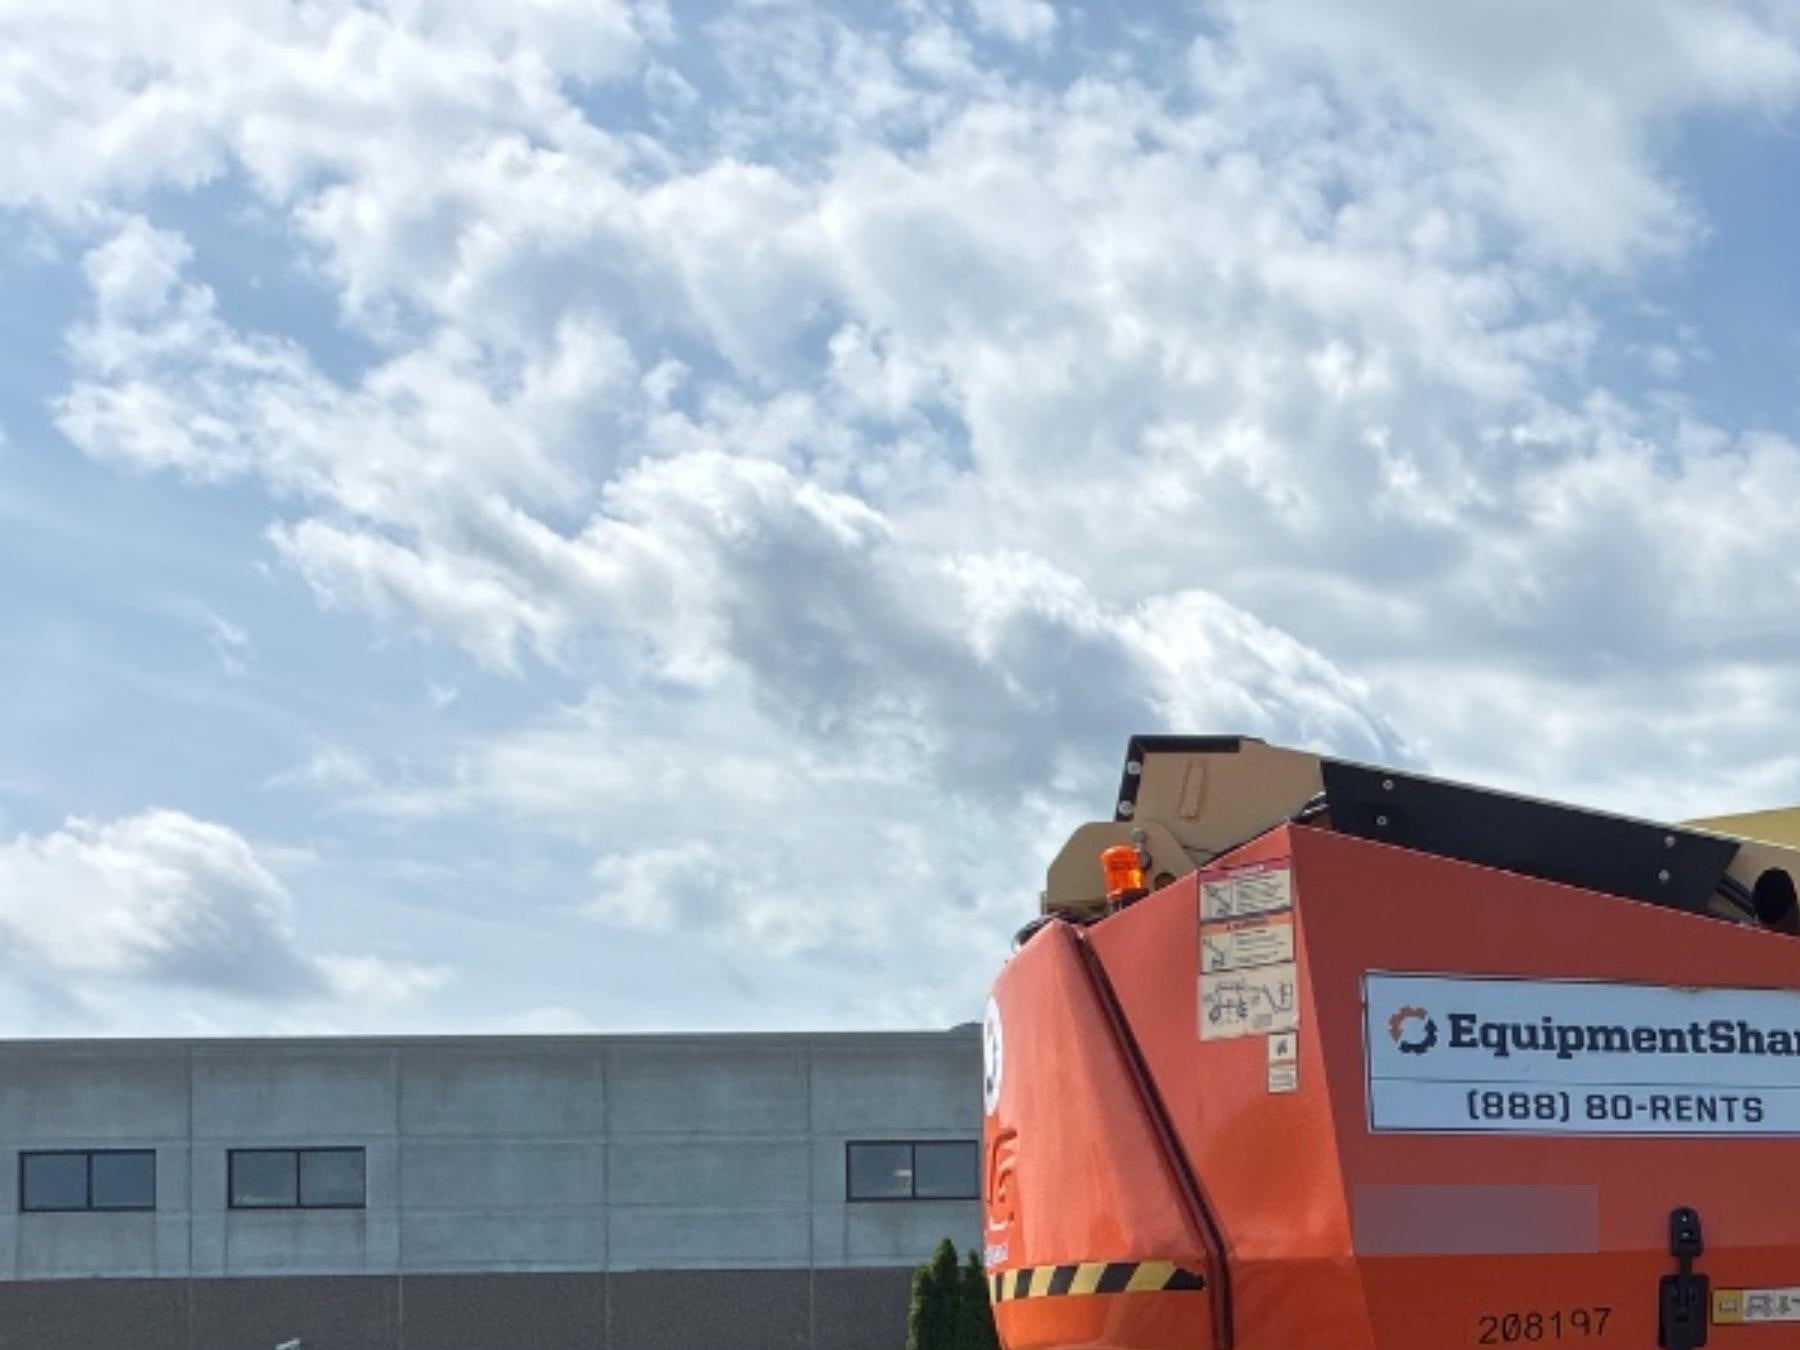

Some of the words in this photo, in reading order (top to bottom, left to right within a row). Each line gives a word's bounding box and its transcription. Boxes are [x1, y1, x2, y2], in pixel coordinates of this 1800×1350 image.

[1467, 1089, 1570, 1122] (888)
[1585, 1093, 1764, 1124] 80-RENTS
[1478, 1307, 1612, 1345] 208197
